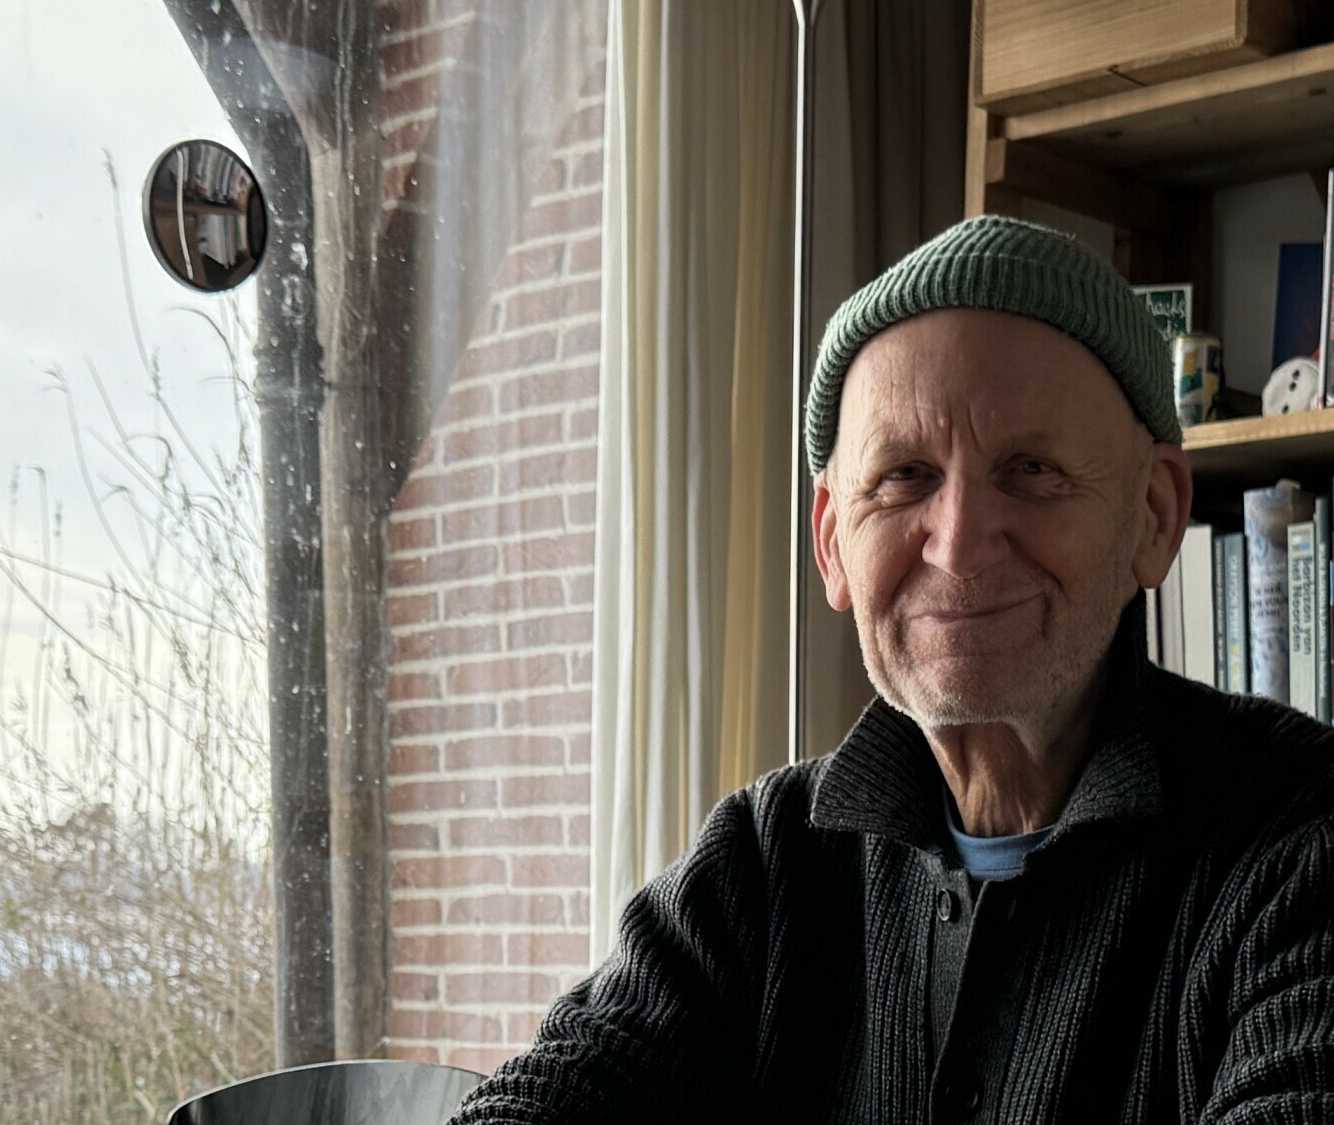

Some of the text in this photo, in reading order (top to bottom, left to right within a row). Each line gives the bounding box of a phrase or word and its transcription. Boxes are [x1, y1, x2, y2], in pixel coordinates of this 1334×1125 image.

[1292, 558, 1304, 652] het Noorden
[1302, 556, 1314, 656] Barbizon van
